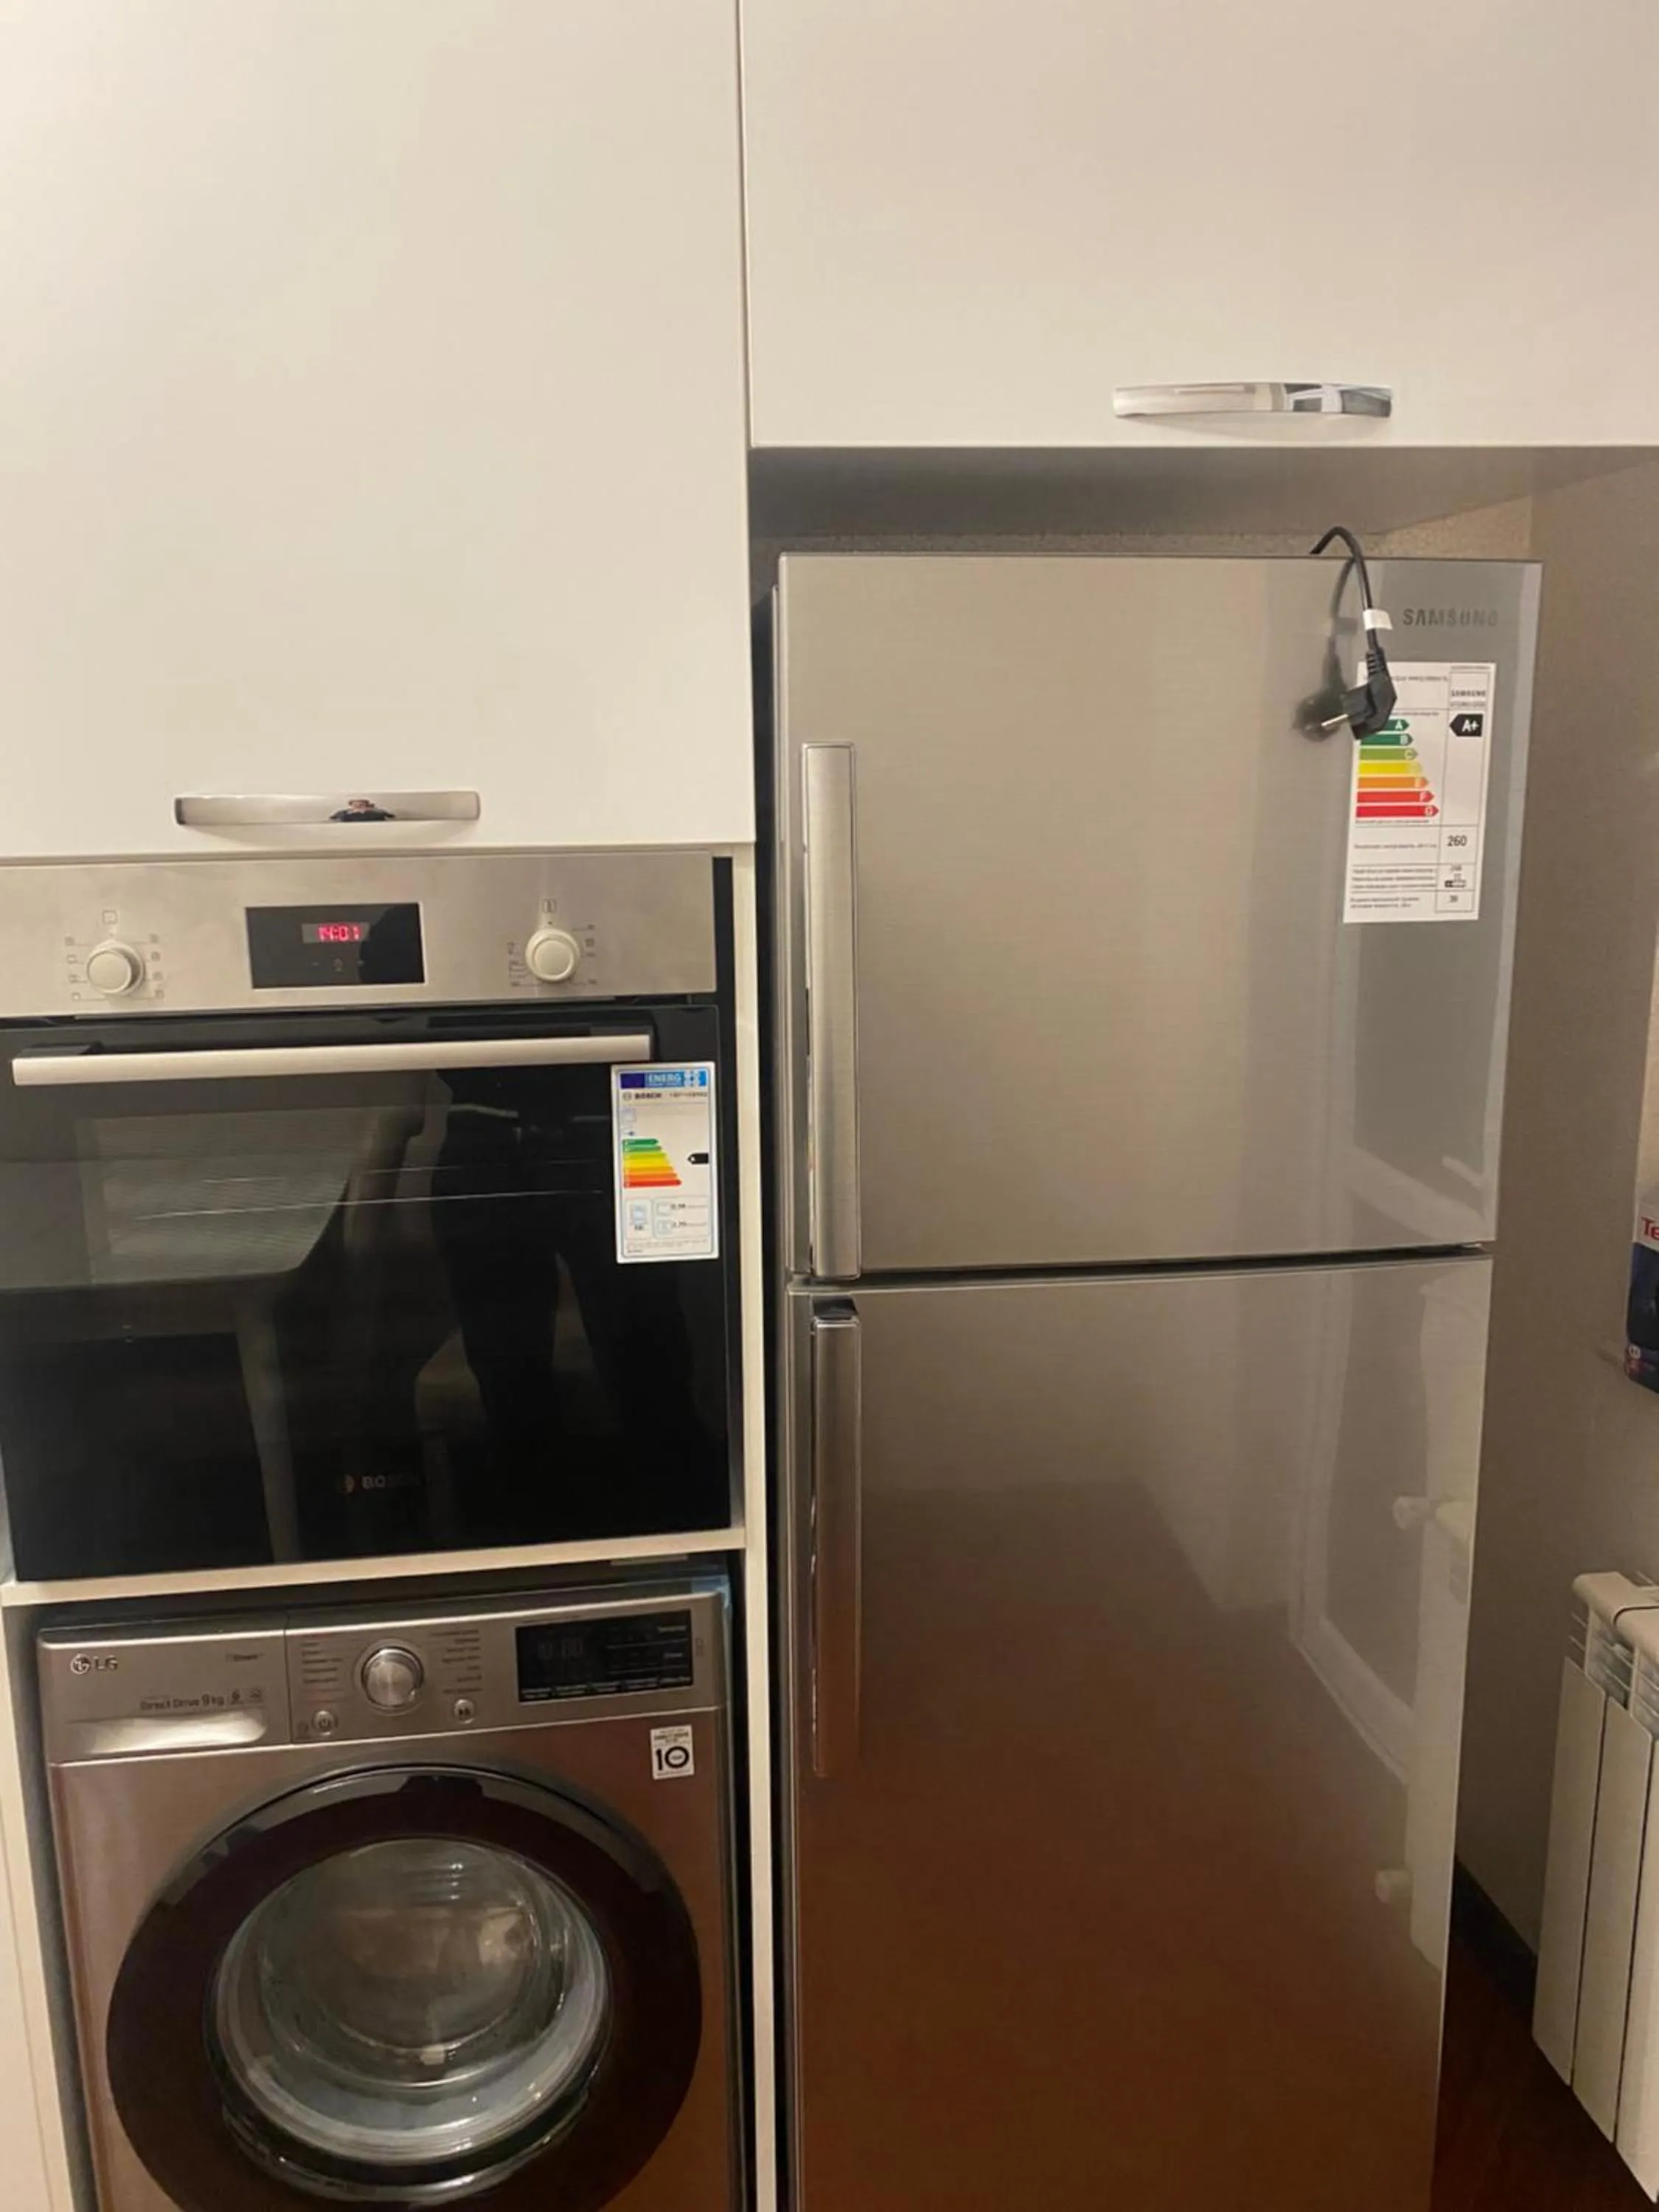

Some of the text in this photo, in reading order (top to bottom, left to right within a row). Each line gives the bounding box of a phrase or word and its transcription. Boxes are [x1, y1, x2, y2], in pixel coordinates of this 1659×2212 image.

[1402, 608, 1498, 627] SAMSUNG
[1461, 719, 1479, 732] A+
[1447, 835, 1467, 847] 260
[656, 1746, 689, 1771] 10
